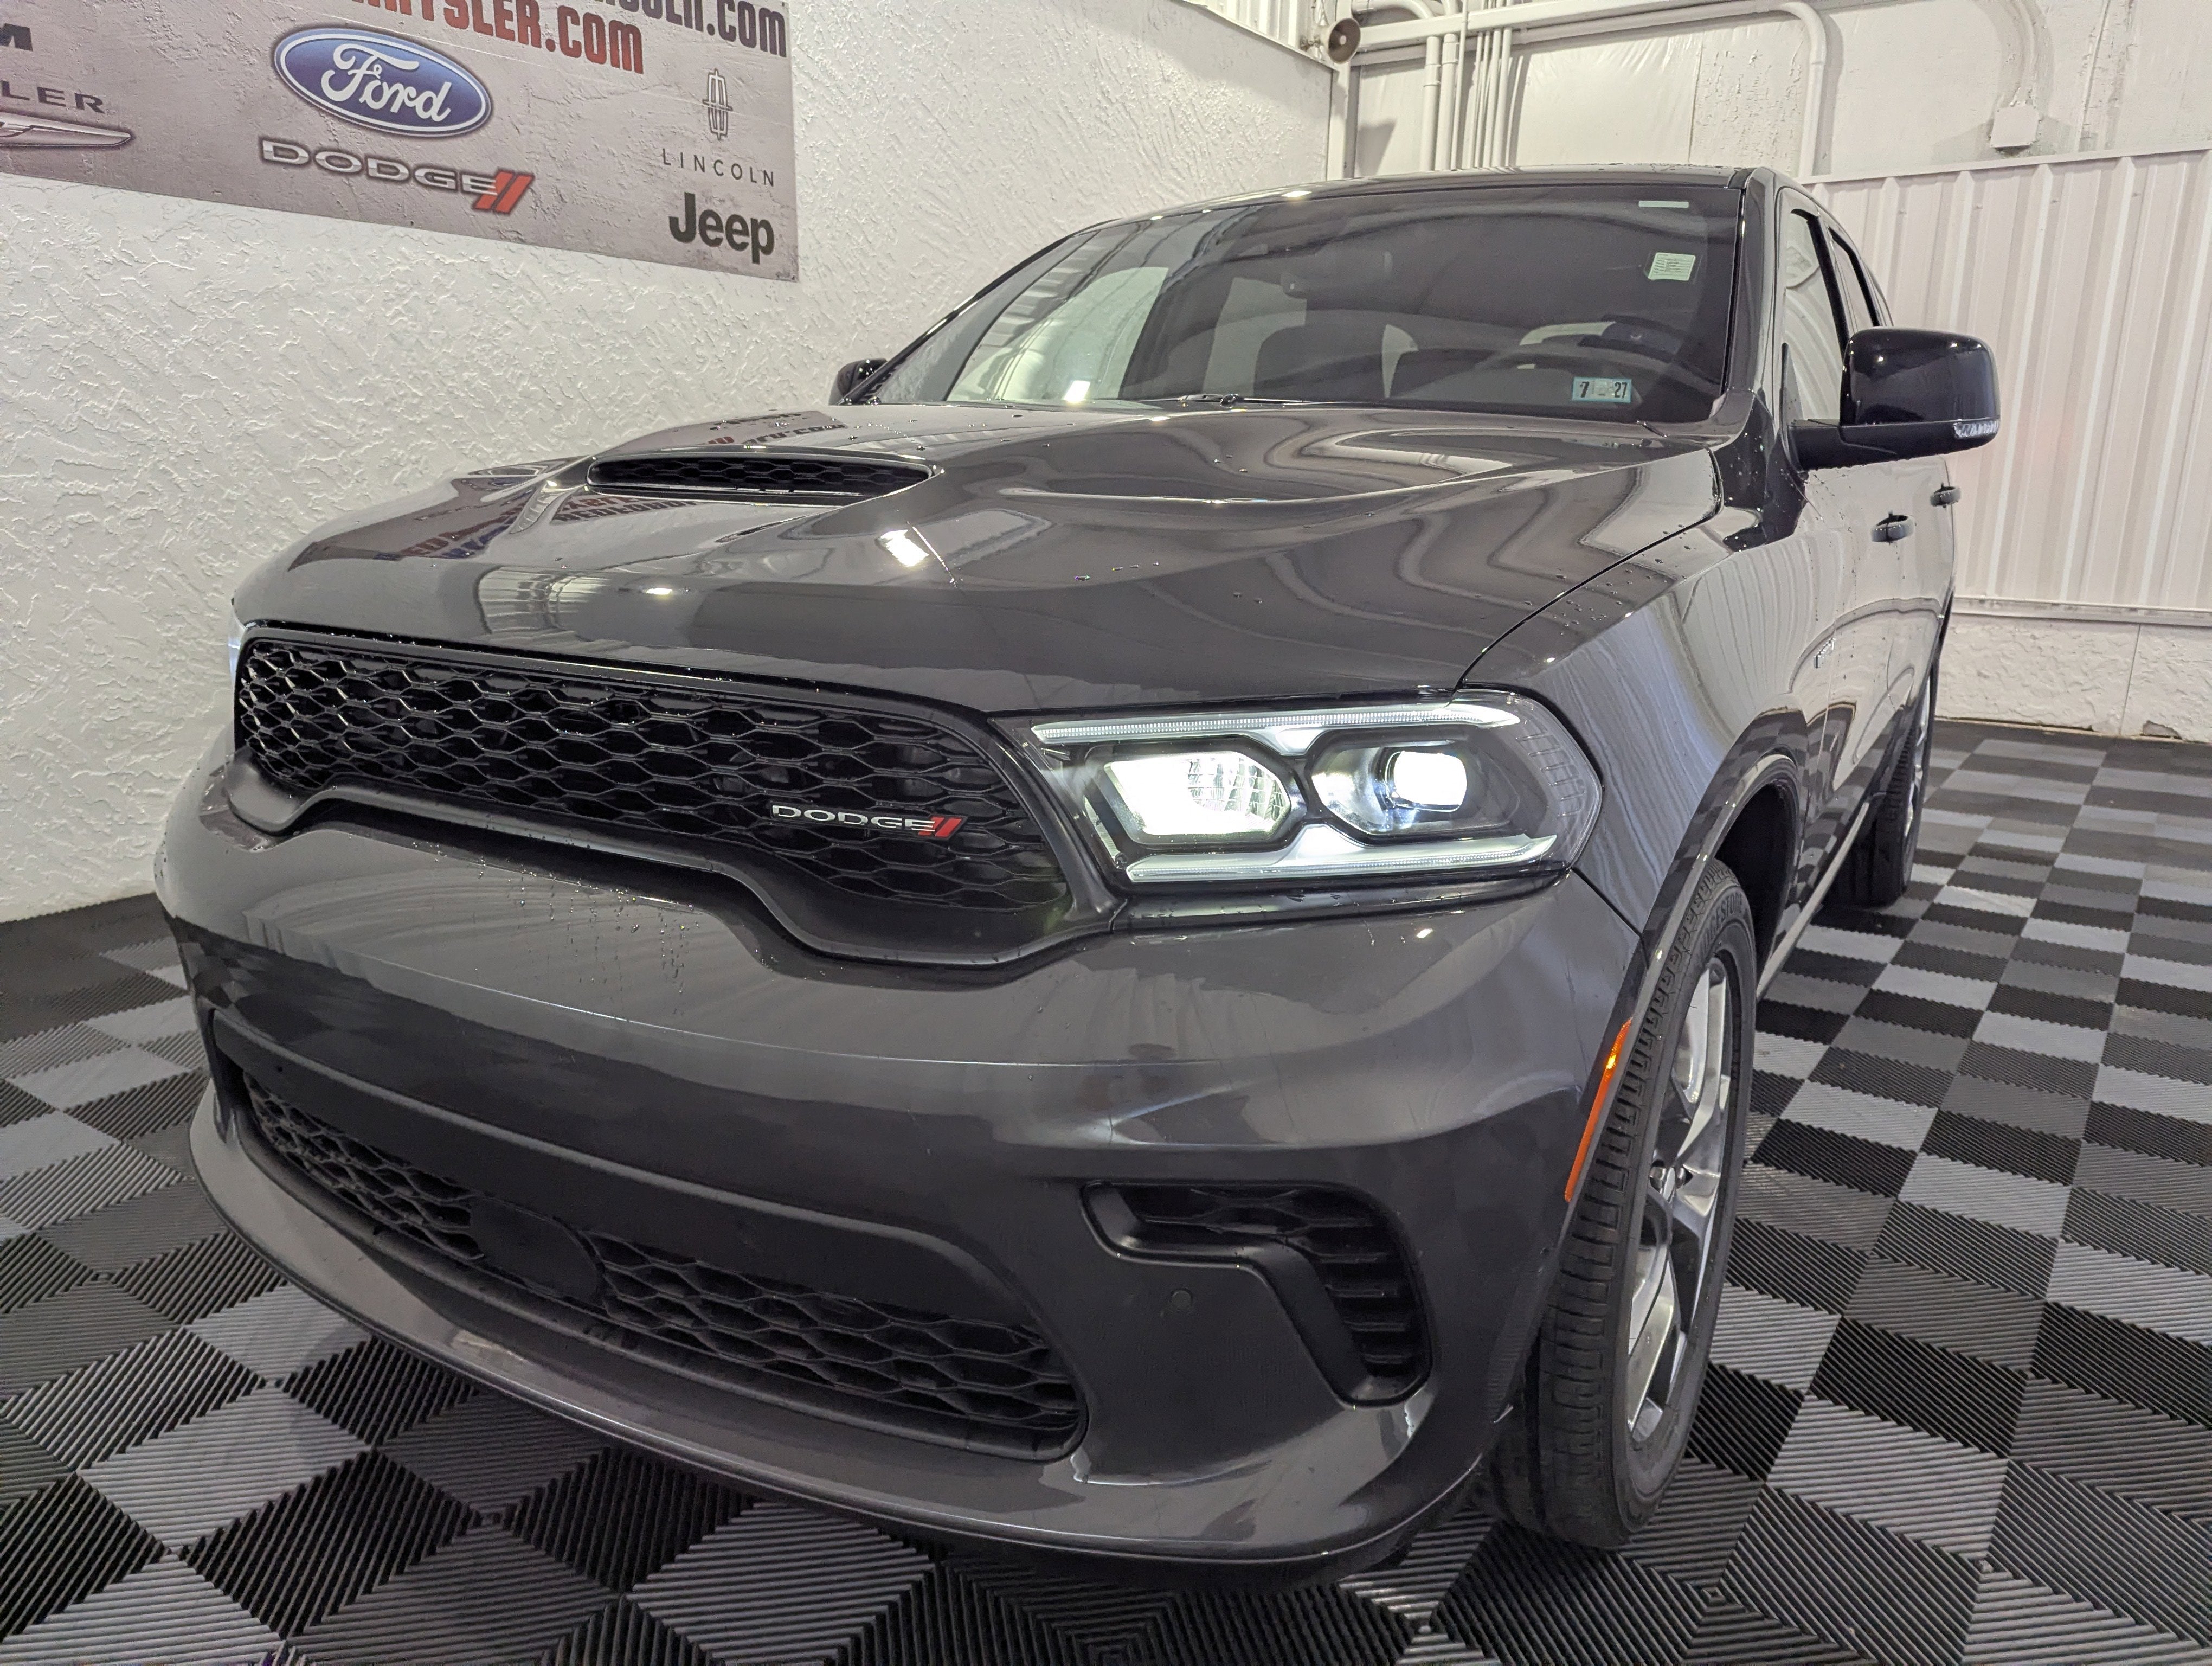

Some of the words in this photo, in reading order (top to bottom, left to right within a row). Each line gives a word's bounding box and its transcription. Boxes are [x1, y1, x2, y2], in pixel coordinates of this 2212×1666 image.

[320, 43, 453, 122] Ford
[262, 139, 498, 196] DODGE
[662, 148, 774, 187] LINCOLN
[668, 191, 775, 265] Jeep
[1579, 381, 1590, 398] 7
[1614, 381, 1628, 399] 27
[771, 805, 936, 832] DODGE
